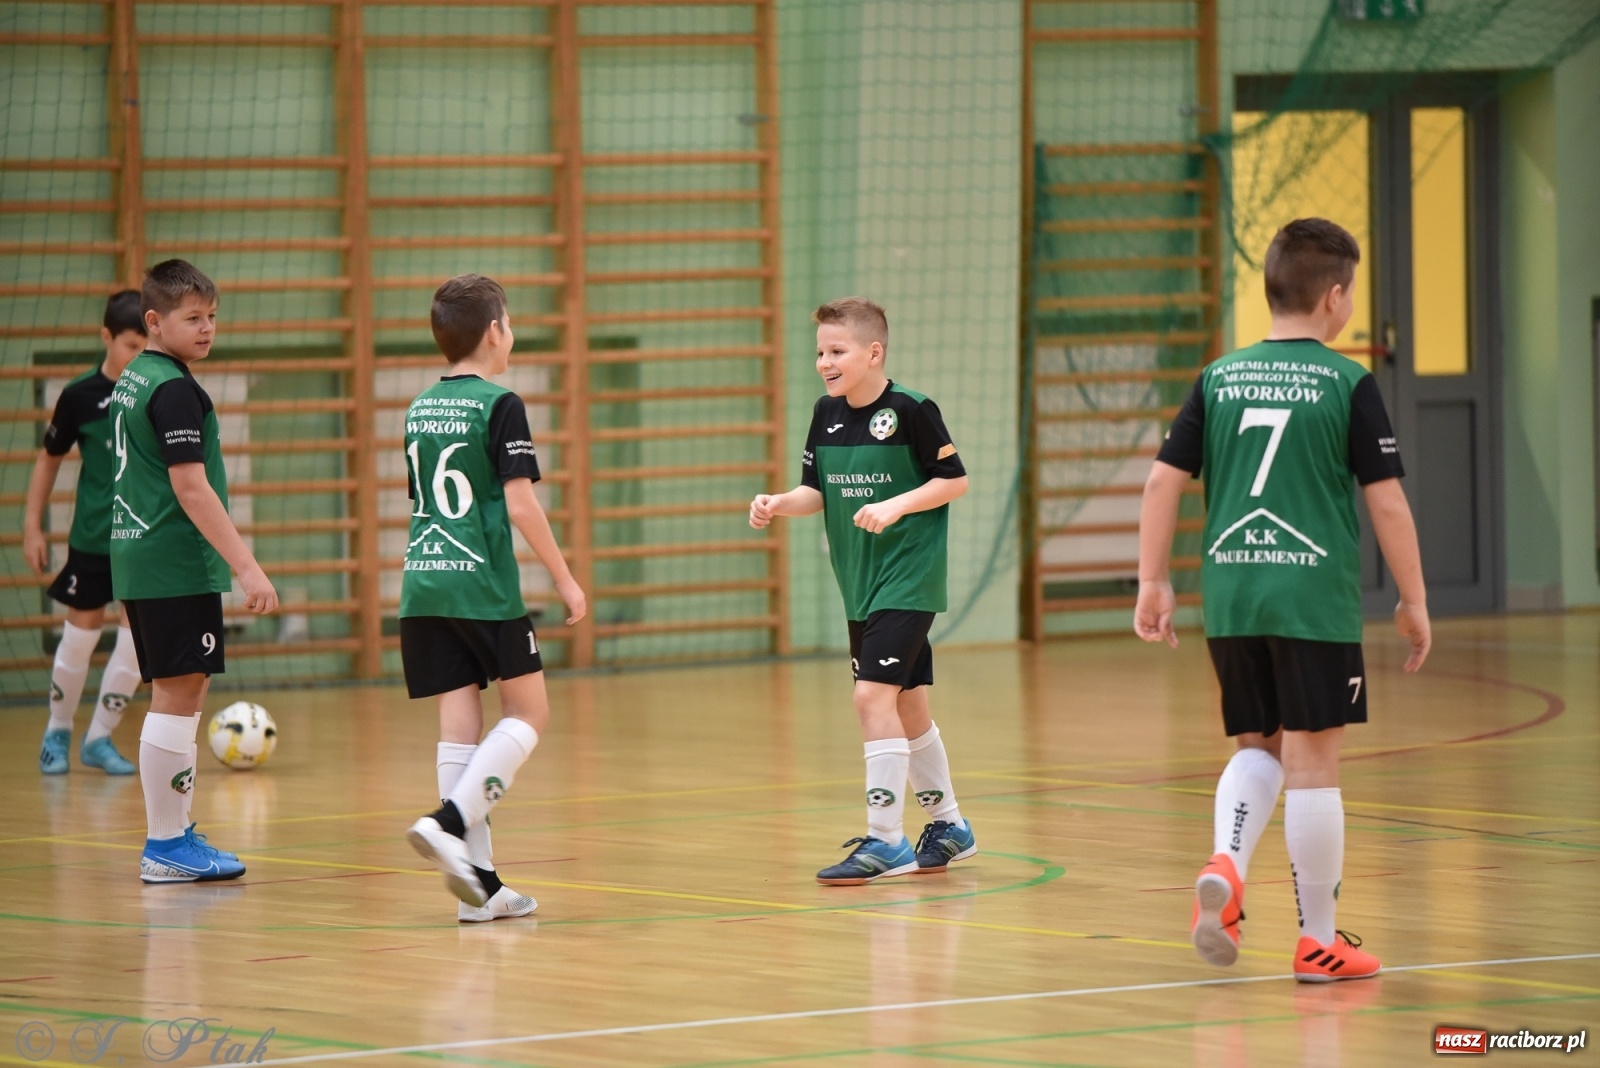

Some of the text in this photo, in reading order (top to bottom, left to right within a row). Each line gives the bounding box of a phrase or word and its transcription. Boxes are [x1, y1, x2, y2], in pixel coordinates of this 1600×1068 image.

[1214, 383, 1325, 404] TWORKÓW
[406, 417, 471, 435] WORKÓW
[1238, 407, 1292, 497] 7
[407, 440, 474, 519] 16
[826, 473, 893, 484] RESTAURACJA
[841, 487, 874, 498] BRAVO
[1244, 529, 1278, 545] K.K
[422, 542, 445, 555] K.K
[1215, 550, 1318, 567] BAUELEMENTE
[67, 574, 78, 595] 2
[201, 632, 216, 656] 9
[526, 630, 541, 655] 1
[1348, 676, 1362, 704] 7
